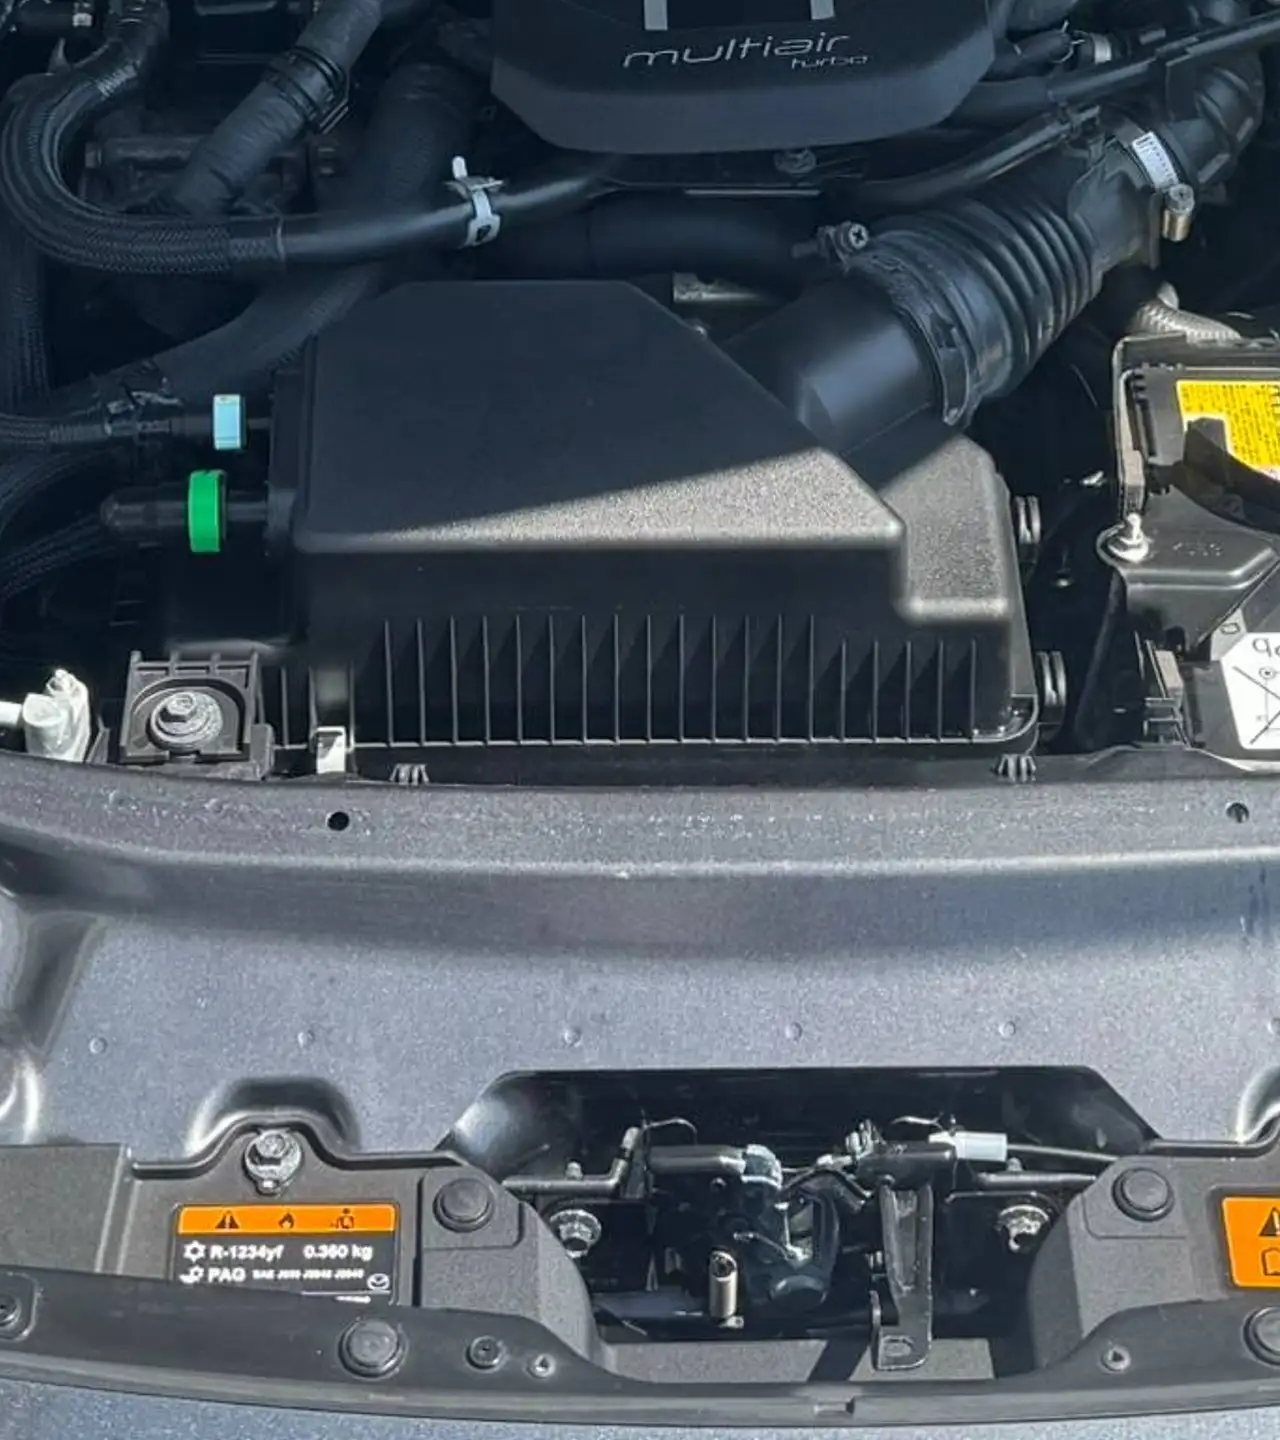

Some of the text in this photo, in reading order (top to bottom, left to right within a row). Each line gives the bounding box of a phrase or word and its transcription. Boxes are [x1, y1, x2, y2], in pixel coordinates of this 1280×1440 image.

[623, 31, 851, 68] multiair
[791, 56, 868, 69] turbo
[209, 1244, 285, 1262] R-1234yf
[351, 1244, 374, 1261] kg
